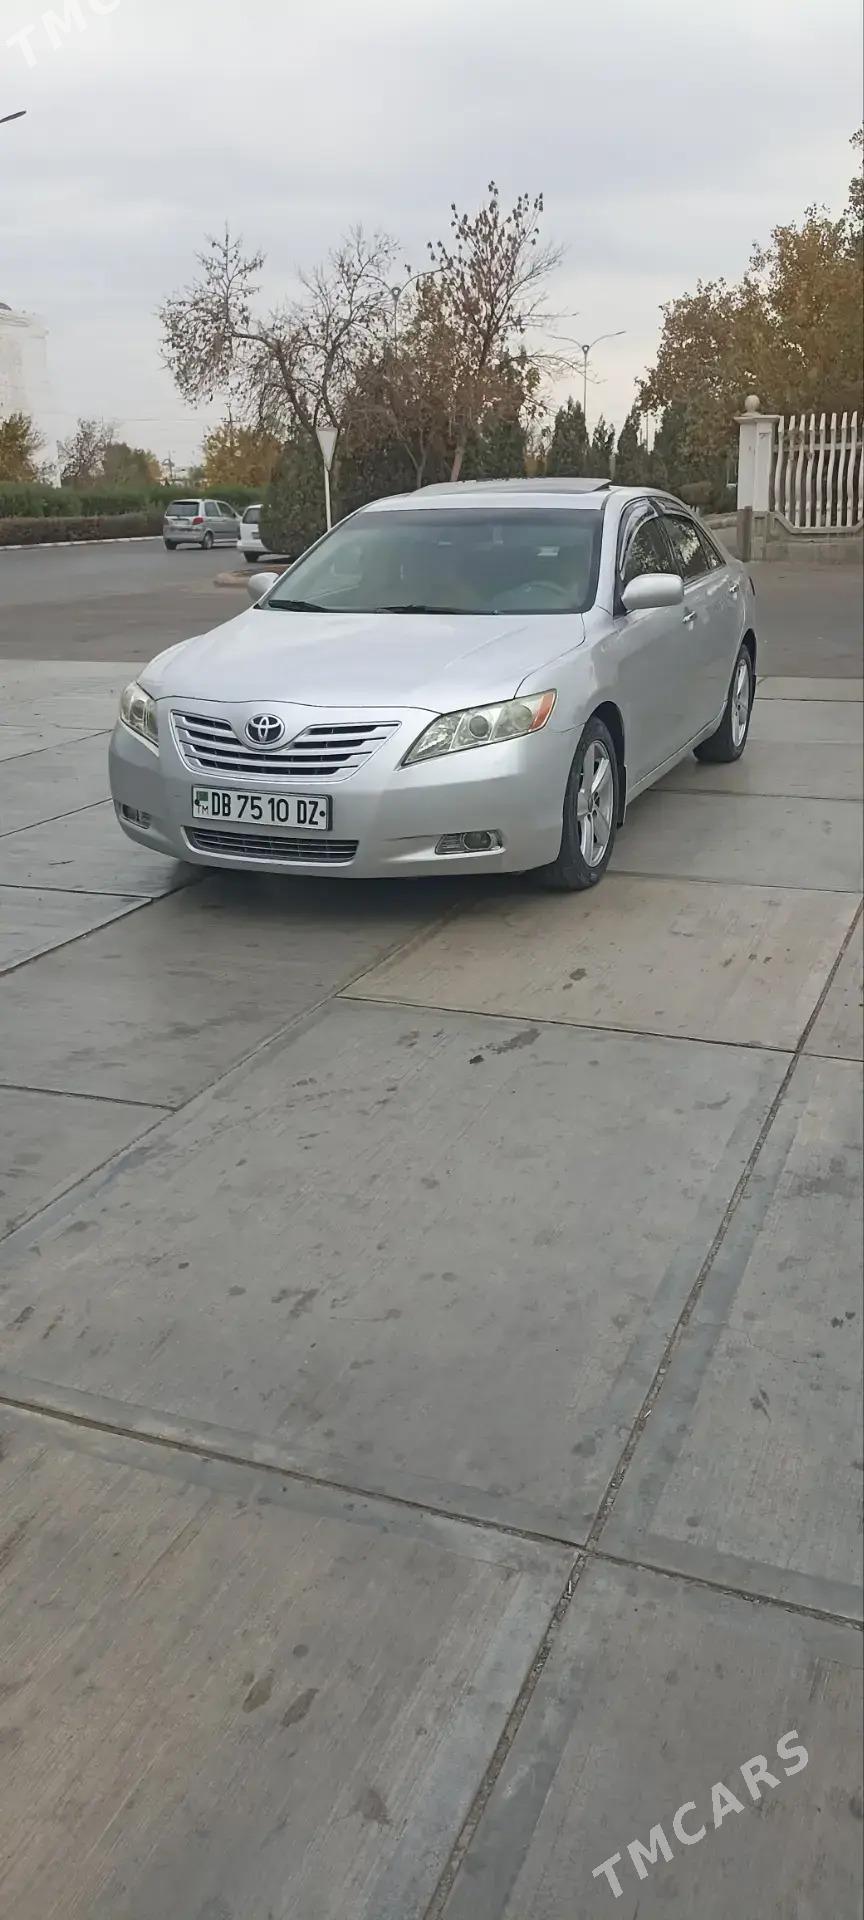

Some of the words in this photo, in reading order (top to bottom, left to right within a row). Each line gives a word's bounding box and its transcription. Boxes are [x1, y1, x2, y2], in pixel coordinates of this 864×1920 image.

[211, 791, 232, 816] DB
[237, 794, 263, 819] 75
[267, 797, 290, 822] 10
[296, 799, 319, 826] DZ
